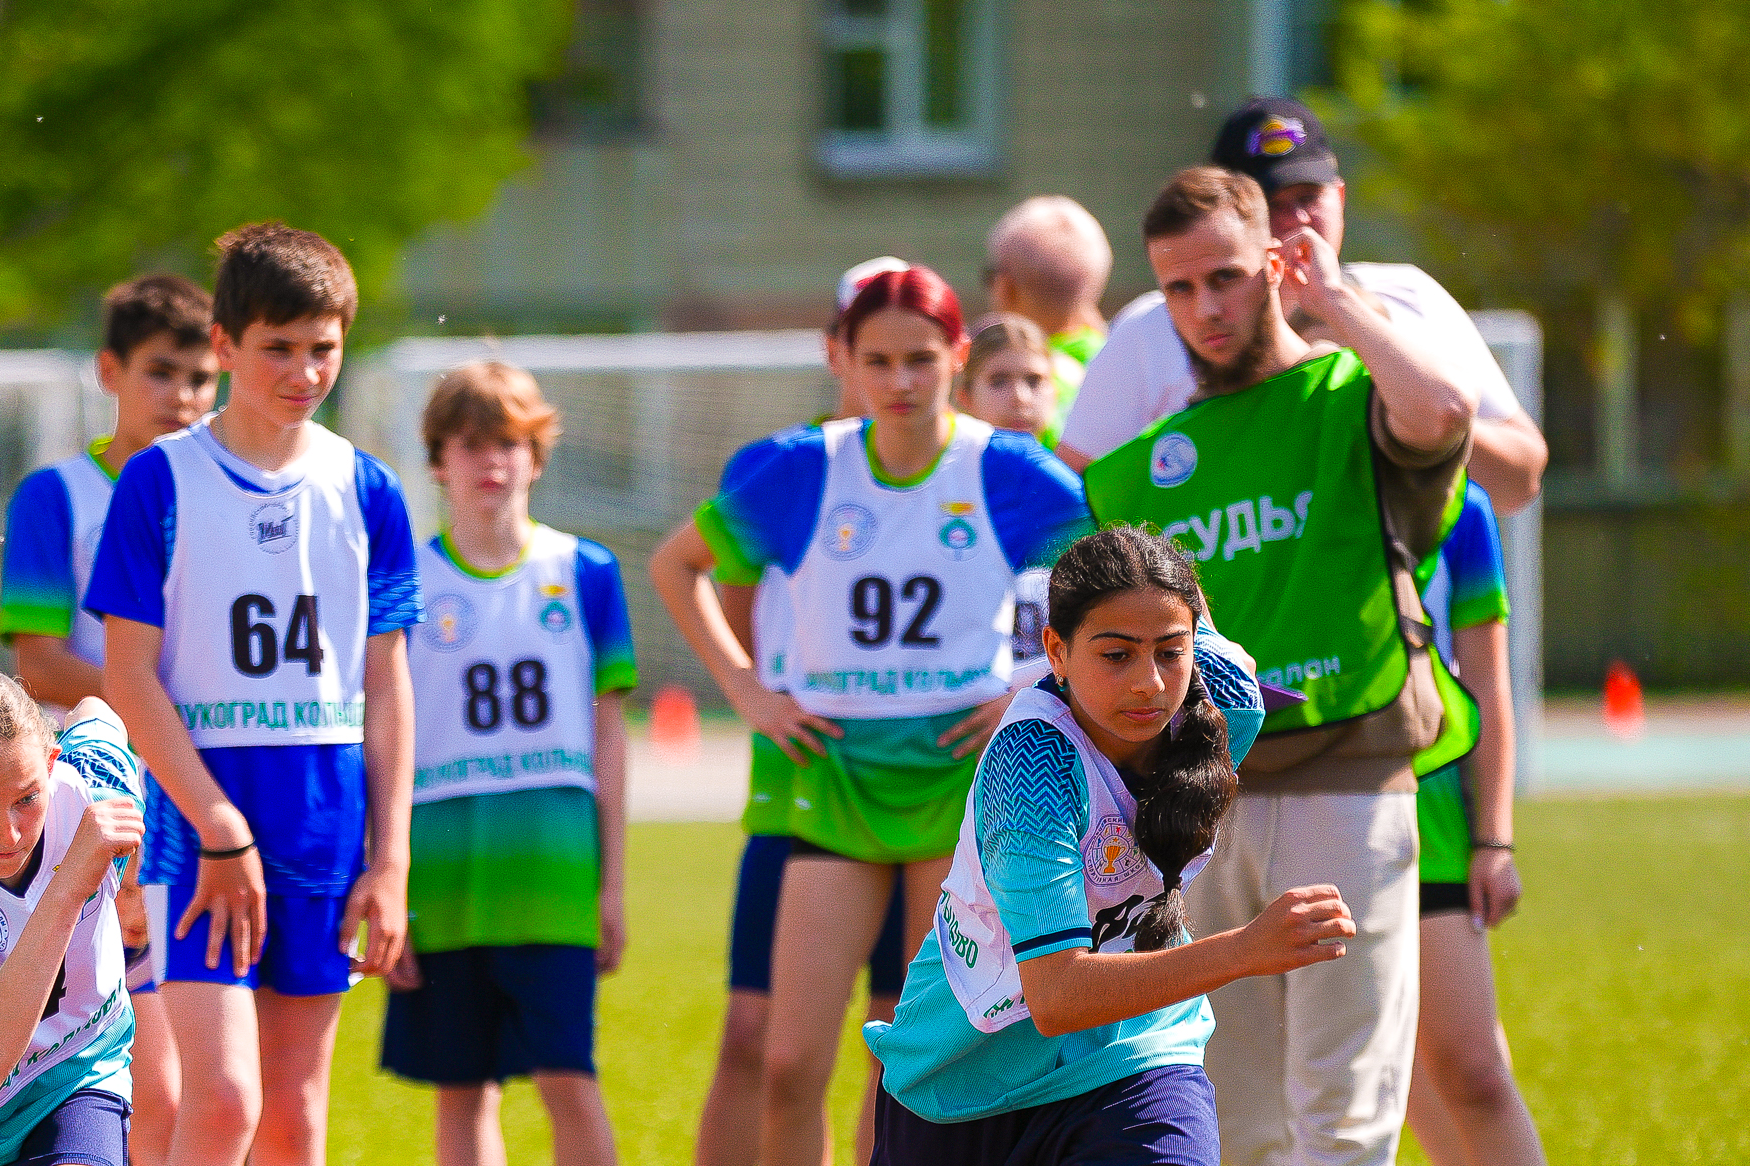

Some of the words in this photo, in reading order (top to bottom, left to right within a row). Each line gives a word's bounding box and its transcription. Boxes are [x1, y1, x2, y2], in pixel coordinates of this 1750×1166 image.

[230, 593, 324, 679] 64
[850, 575, 943, 650] 92
[462, 658, 553, 736] 88
